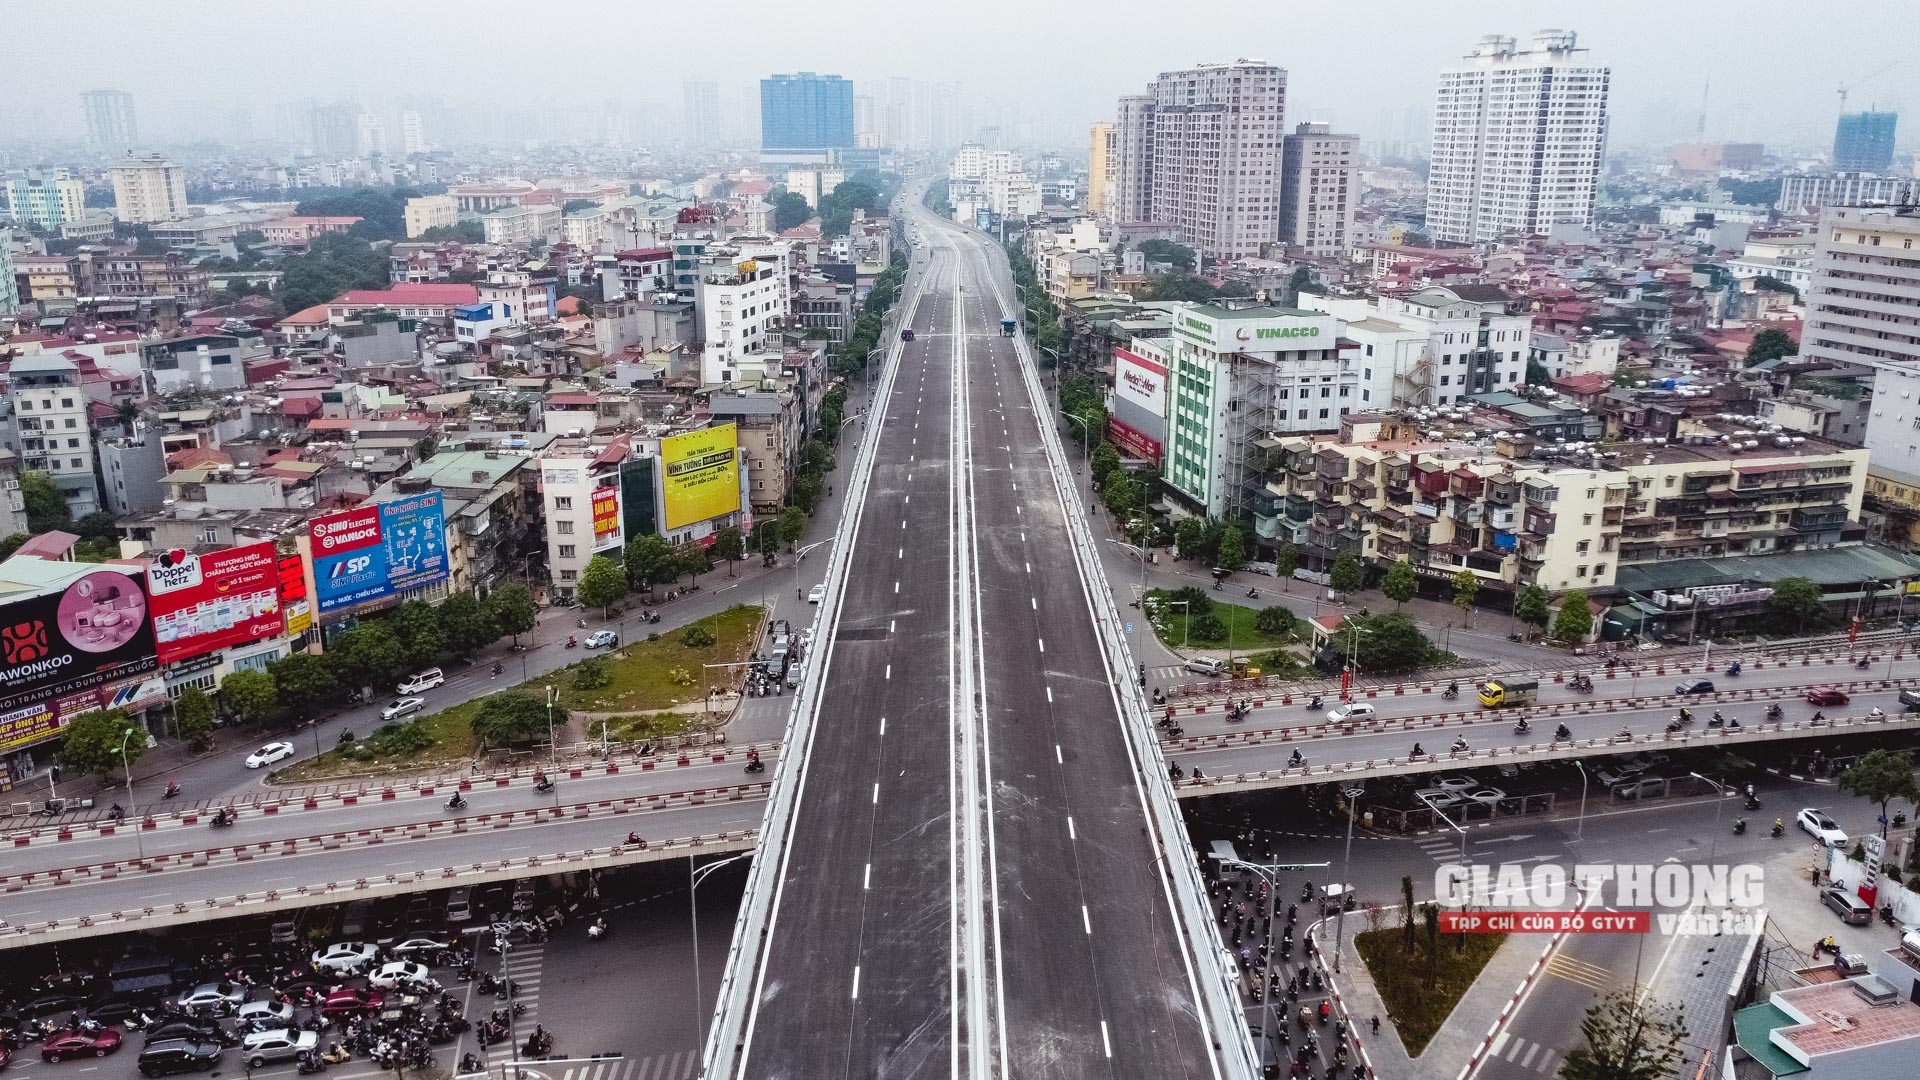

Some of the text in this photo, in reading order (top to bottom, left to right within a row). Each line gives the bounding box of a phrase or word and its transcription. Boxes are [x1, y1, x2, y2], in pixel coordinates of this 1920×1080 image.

[1186, 317, 1212, 334] VINACCO
[1256, 326, 1320, 339] VINACCO
[668, 458, 702, 475] VĨNH TƯỜNG
[327, 517, 376, 534] SINO ELECTRIC
[334, 527, 378, 545] VANLOCK
[214, 553, 260, 568] THƯƠNG HIỆU
[347, 555, 371, 574] SP
[152, 562, 196, 580] Doppel
[204, 568, 226, 578] CHĂM
[225, 565, 240, 574] SÓC
[239, 561, 254, 570] SỨC
[163, 576, 189, 588] herz
[238, 576, 243, 584] 1
[331, 575, 350, 589] SINO
[370, 585, 385, 595] SÁNG
[18, 690, 53, 704] TRANG
[55, 683, 73, 694] GIA
[76, 674, 103, 689] DỤNG
[105, 668, 126, 680] HÀN
[127, 660, 155, 673] QUỐC
[0, 722, 13, 735] ÉP
[15, 717, 35, 729] ỐNG
[35, 712, 54, 724] HỘP
